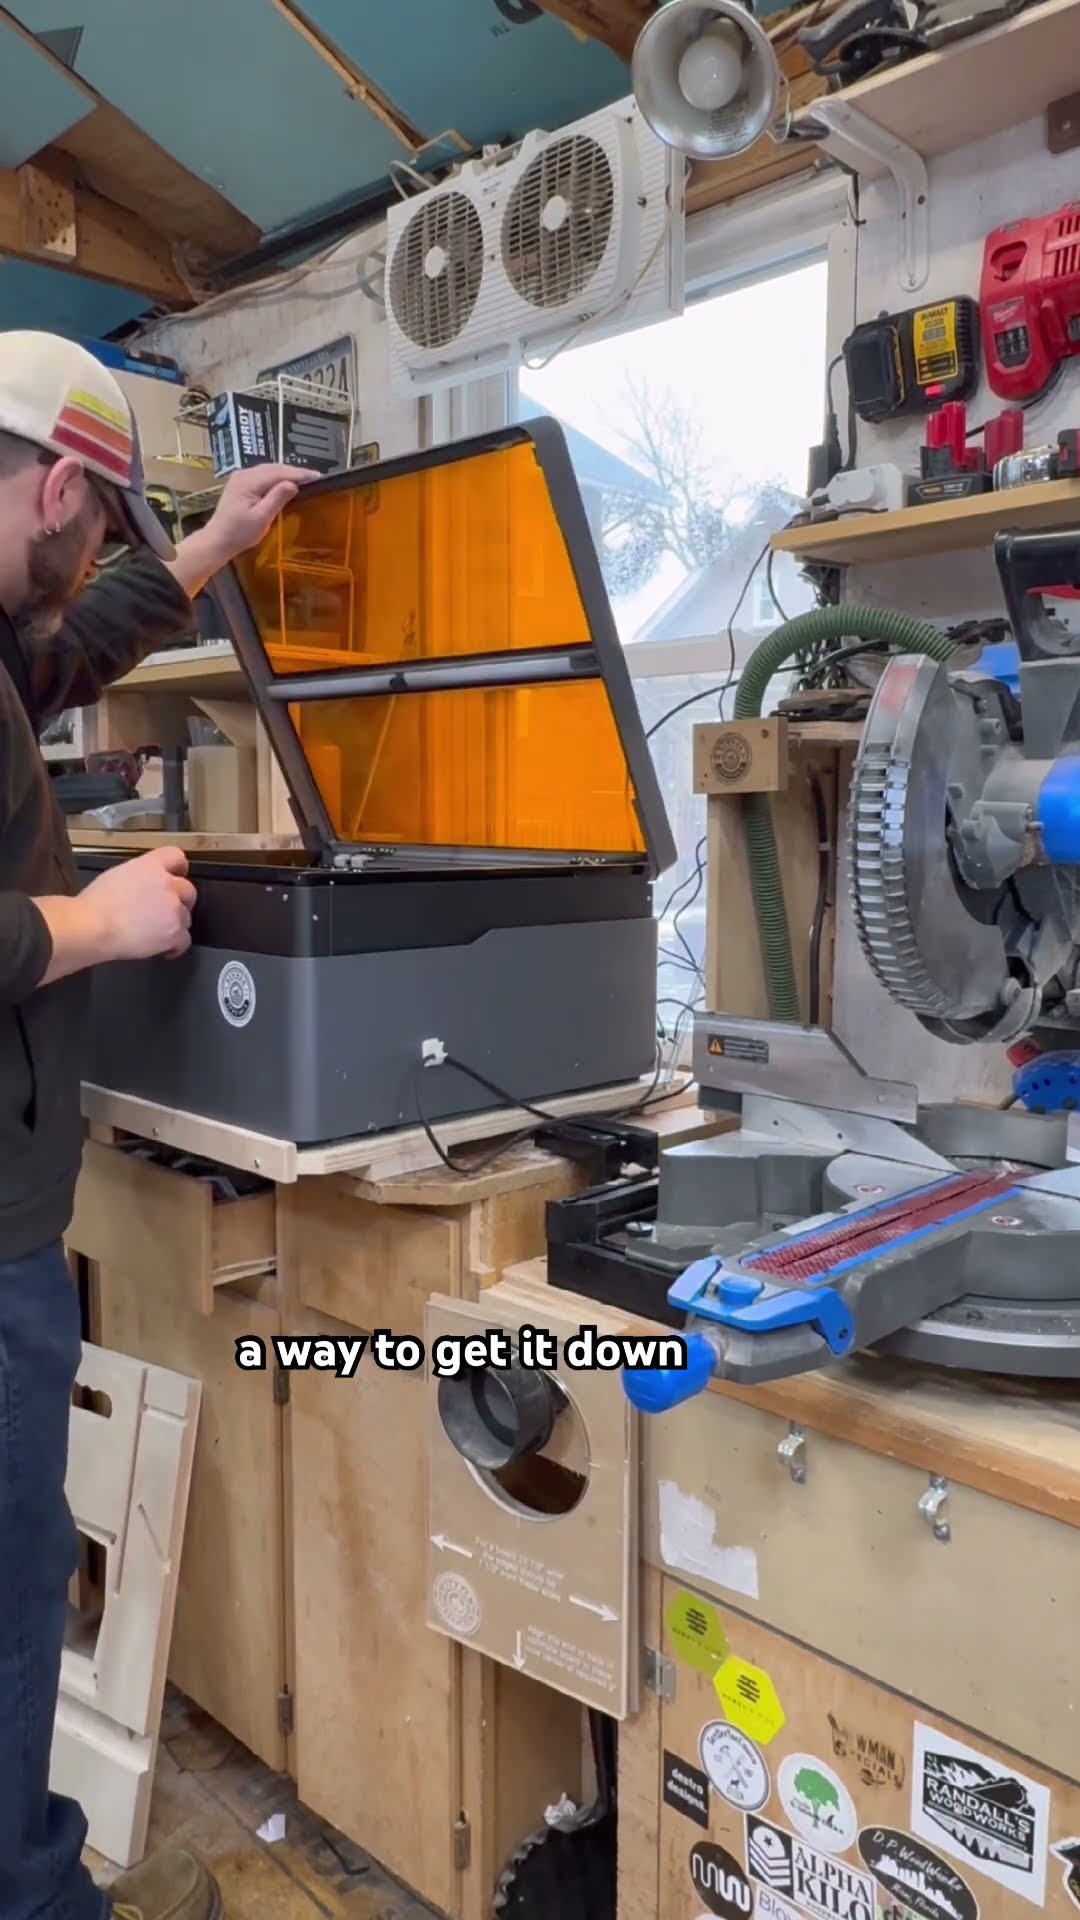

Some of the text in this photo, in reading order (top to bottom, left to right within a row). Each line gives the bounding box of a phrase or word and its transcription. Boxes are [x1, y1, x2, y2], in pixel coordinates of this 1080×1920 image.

[926, 1777, 1031, 1834] RANDALL'S
[929, 1790, 1027, 1843] WOODWORKS
[794, 1846, 872, 1906] ALPHA
[797, 1866, 873, 1920] KILO
